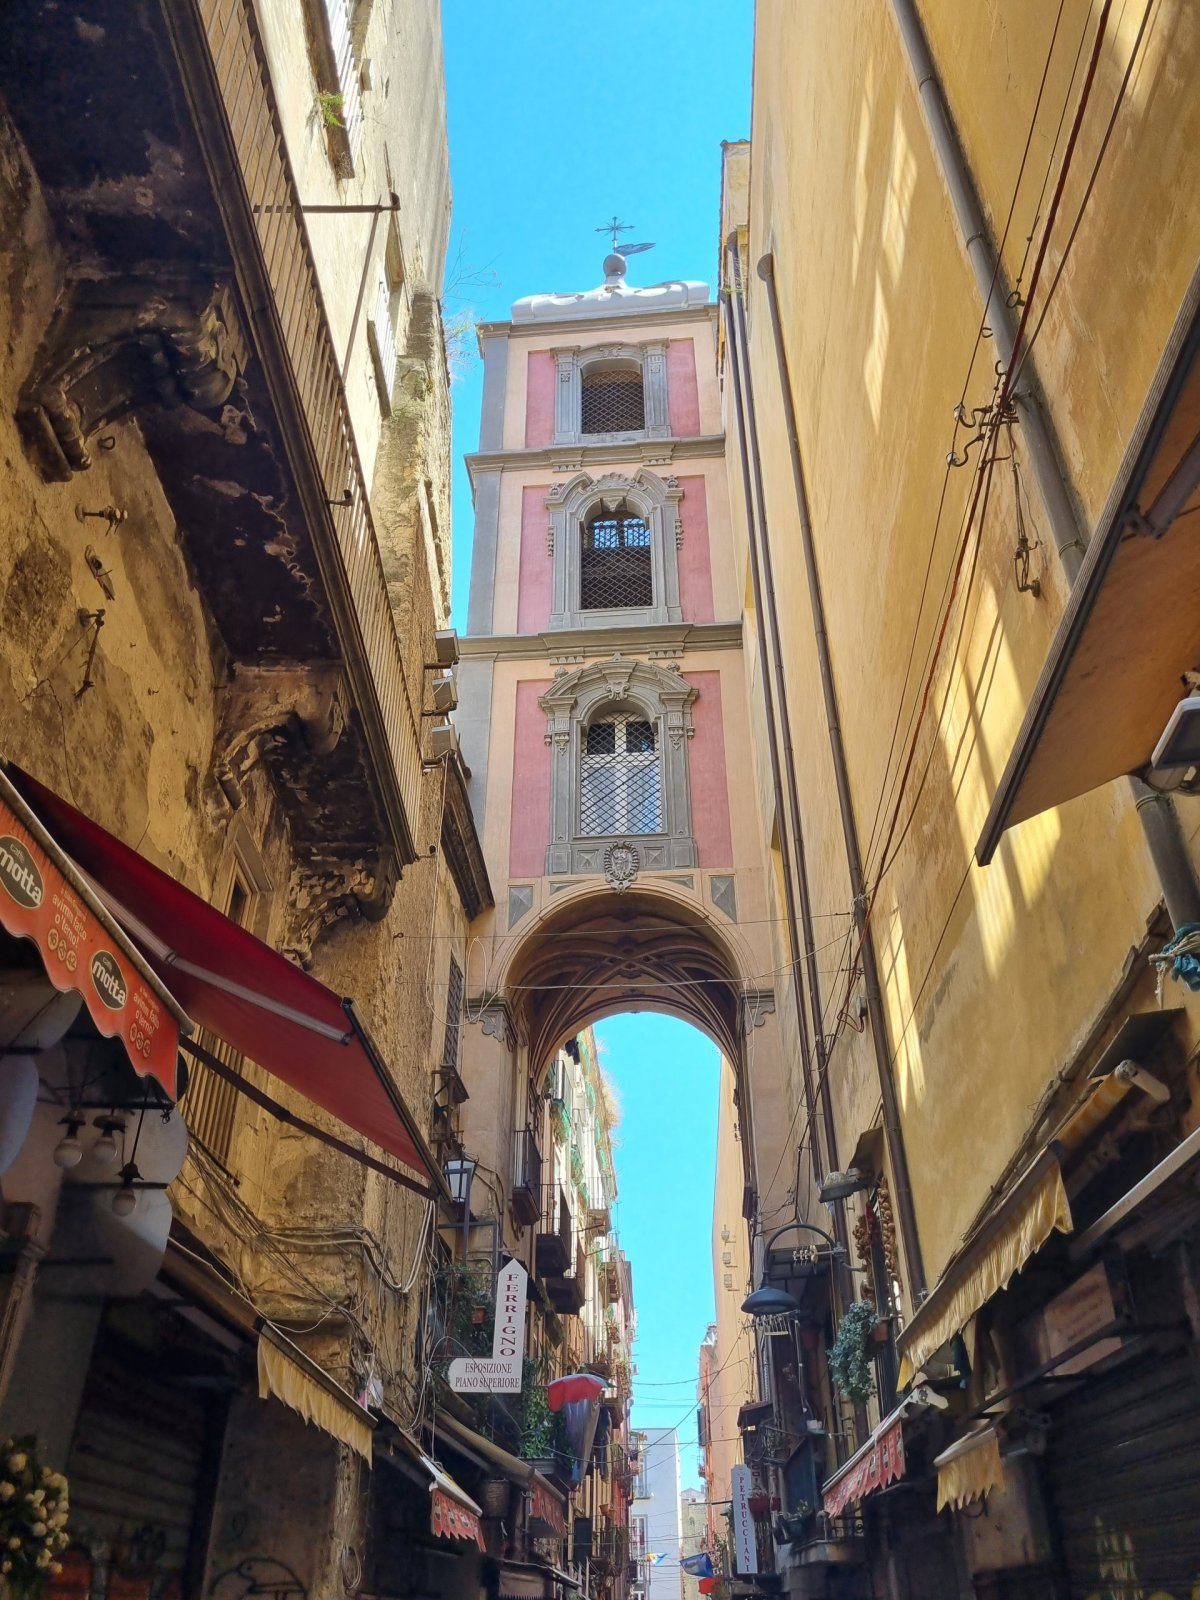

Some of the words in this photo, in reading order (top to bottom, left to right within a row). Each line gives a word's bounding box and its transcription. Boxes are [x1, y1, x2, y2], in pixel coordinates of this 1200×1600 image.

[92, 960, 126, 1006] motta
[500, 1273, 519, 1356] FERRIGNO
[455, 1377, 478, 1388] PIANO
[479, 1377, 520, 1388] SUPERIORE
[465, 1362, 512, 1374] ESPOSIZIONE
[738, 1476, 751, 1572] PETRUCCIANI
